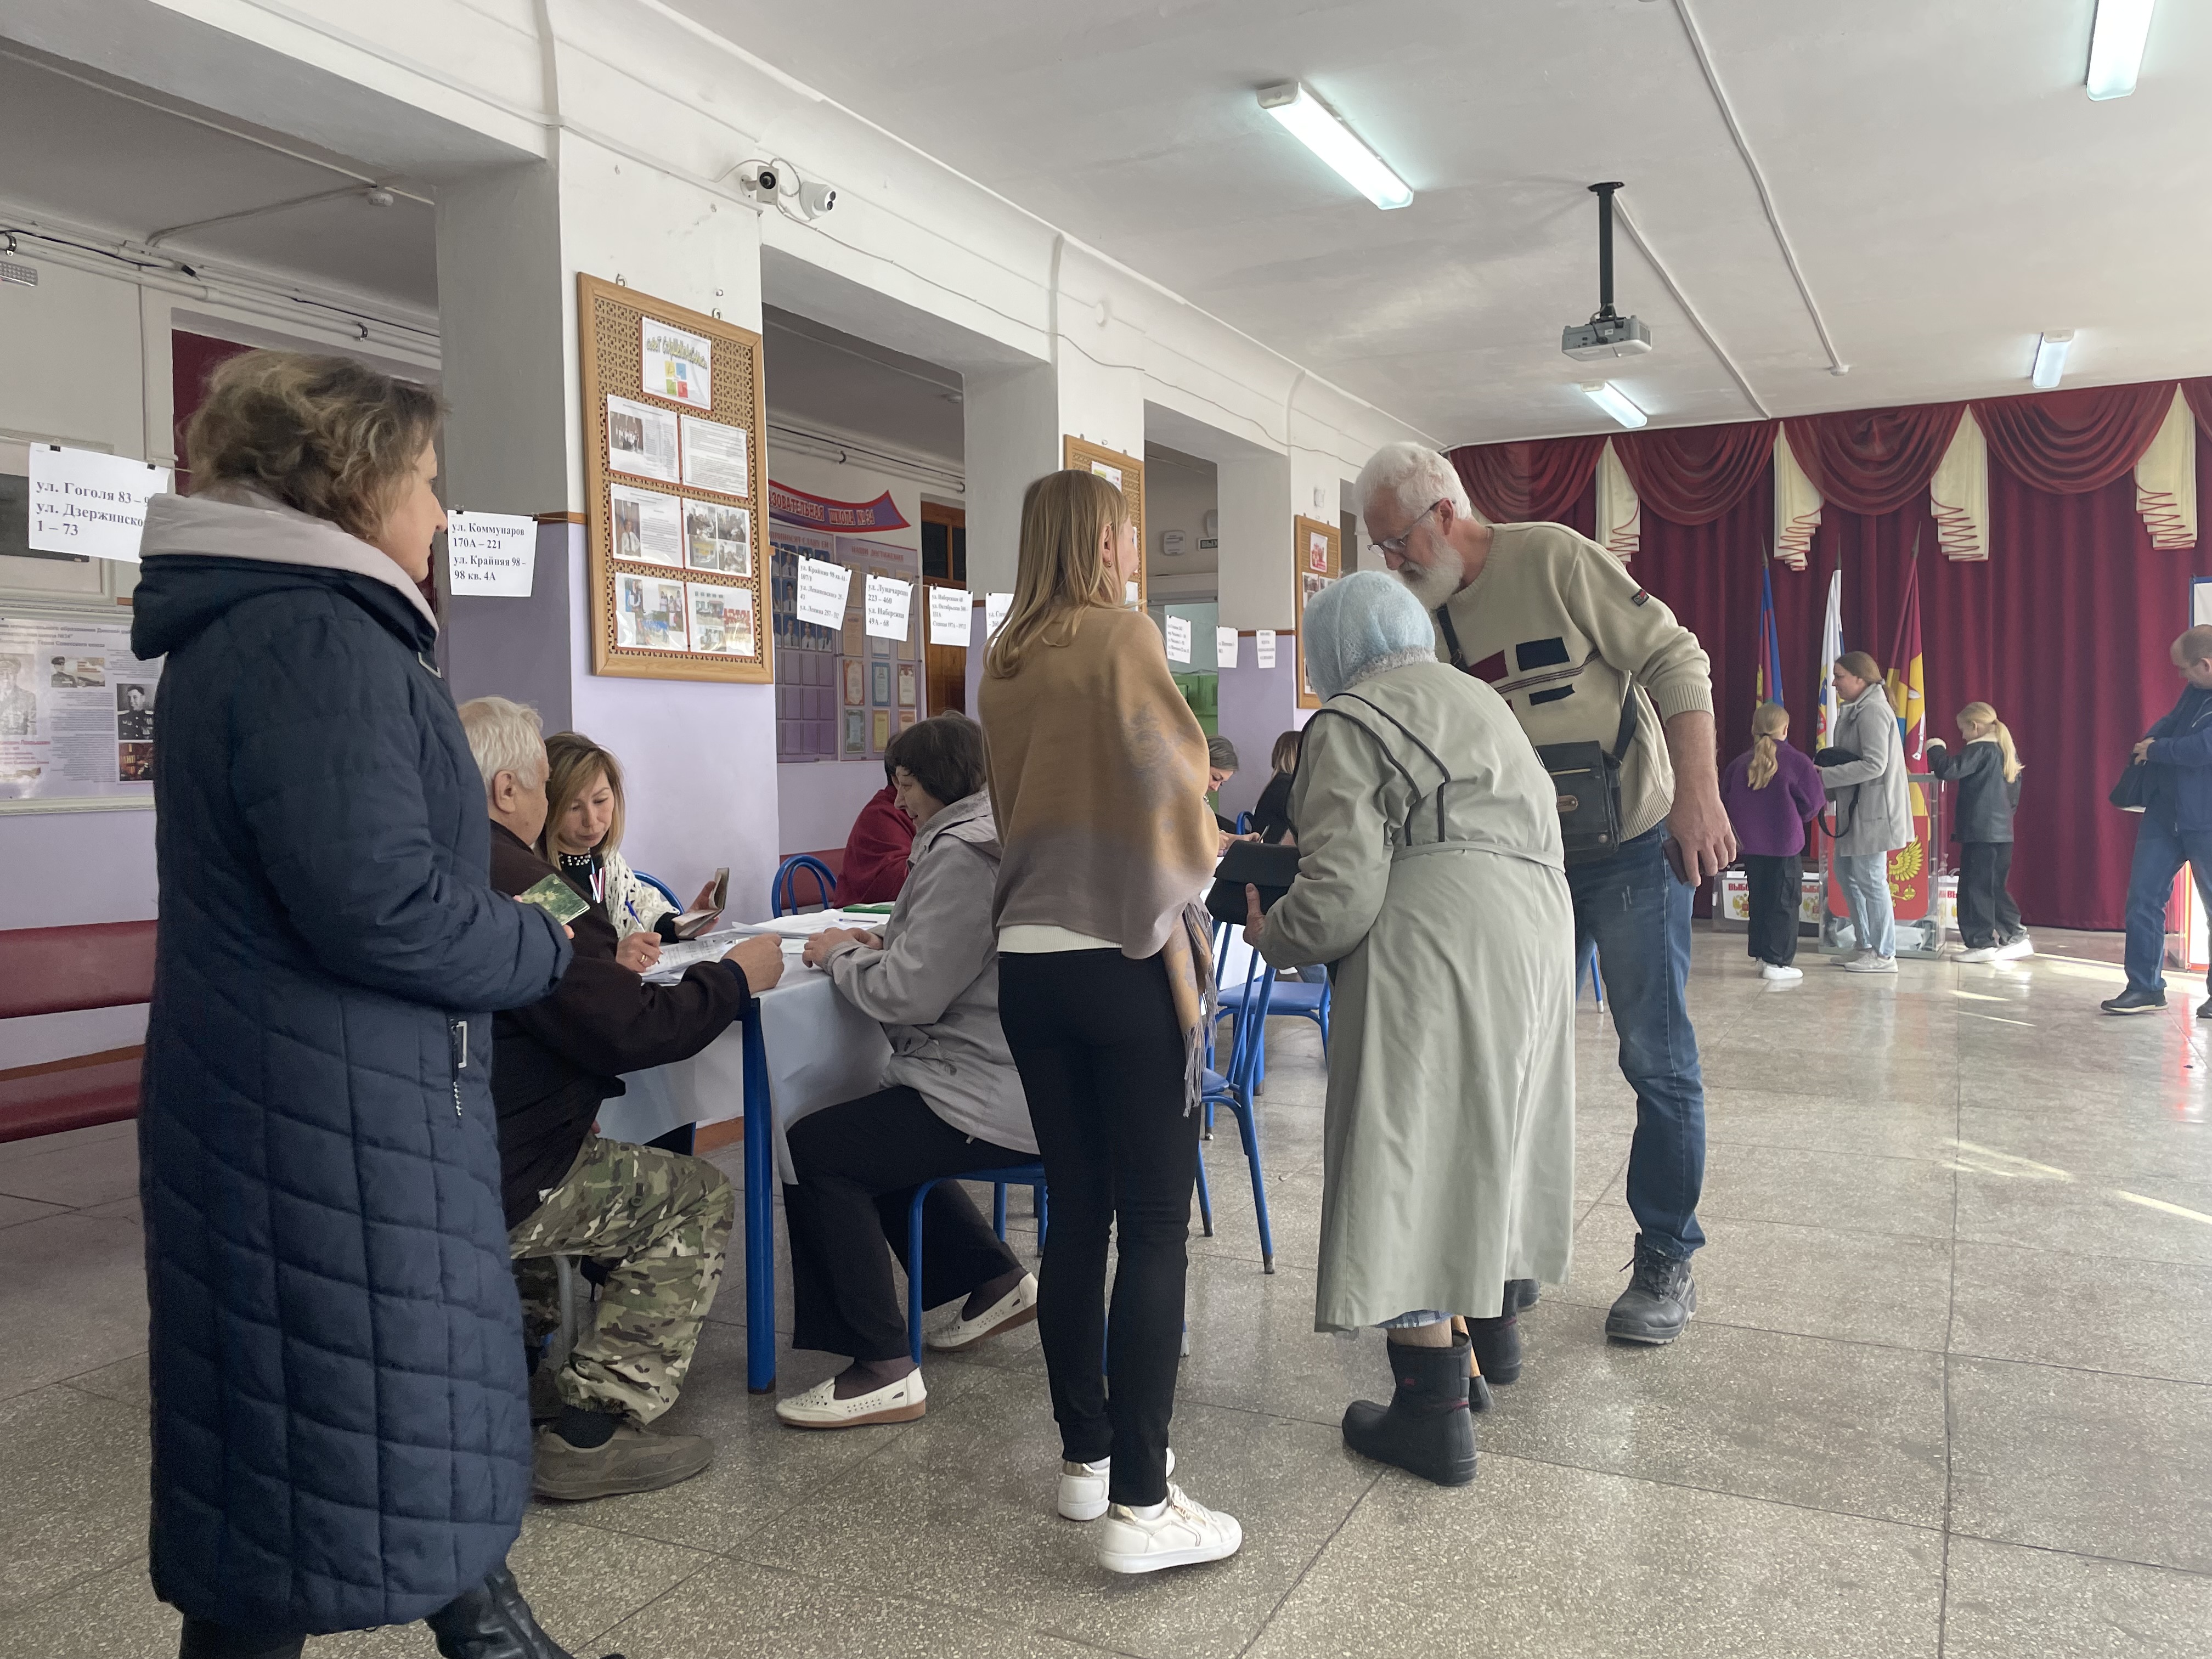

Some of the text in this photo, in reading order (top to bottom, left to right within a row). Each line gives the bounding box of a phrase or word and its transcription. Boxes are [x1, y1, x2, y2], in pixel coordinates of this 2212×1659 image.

[36, 481, 59, 493] ул.
[64, 482, 114, 501] Гоголя
[118, 491, 132, 504] 83
[36, 503, 59, 515] ул.
[828, 508, 856, 526] ШКОЛА
[37, 520, 43, 532] 1
[63, 523, 78, 536] 73
[452, 522, 524, 537] ул. Коммунаров
[453, 538, 476, 548] 170А
[487, 539, 501, 549] 221
[851, 545, 868, 555] НАШИ
[454, 556, 467, 566] ул.
[470, 555, 510, 567] Крайняя
[512, 557, 521, 567] 98
[454, 570, 465, 580] 98
